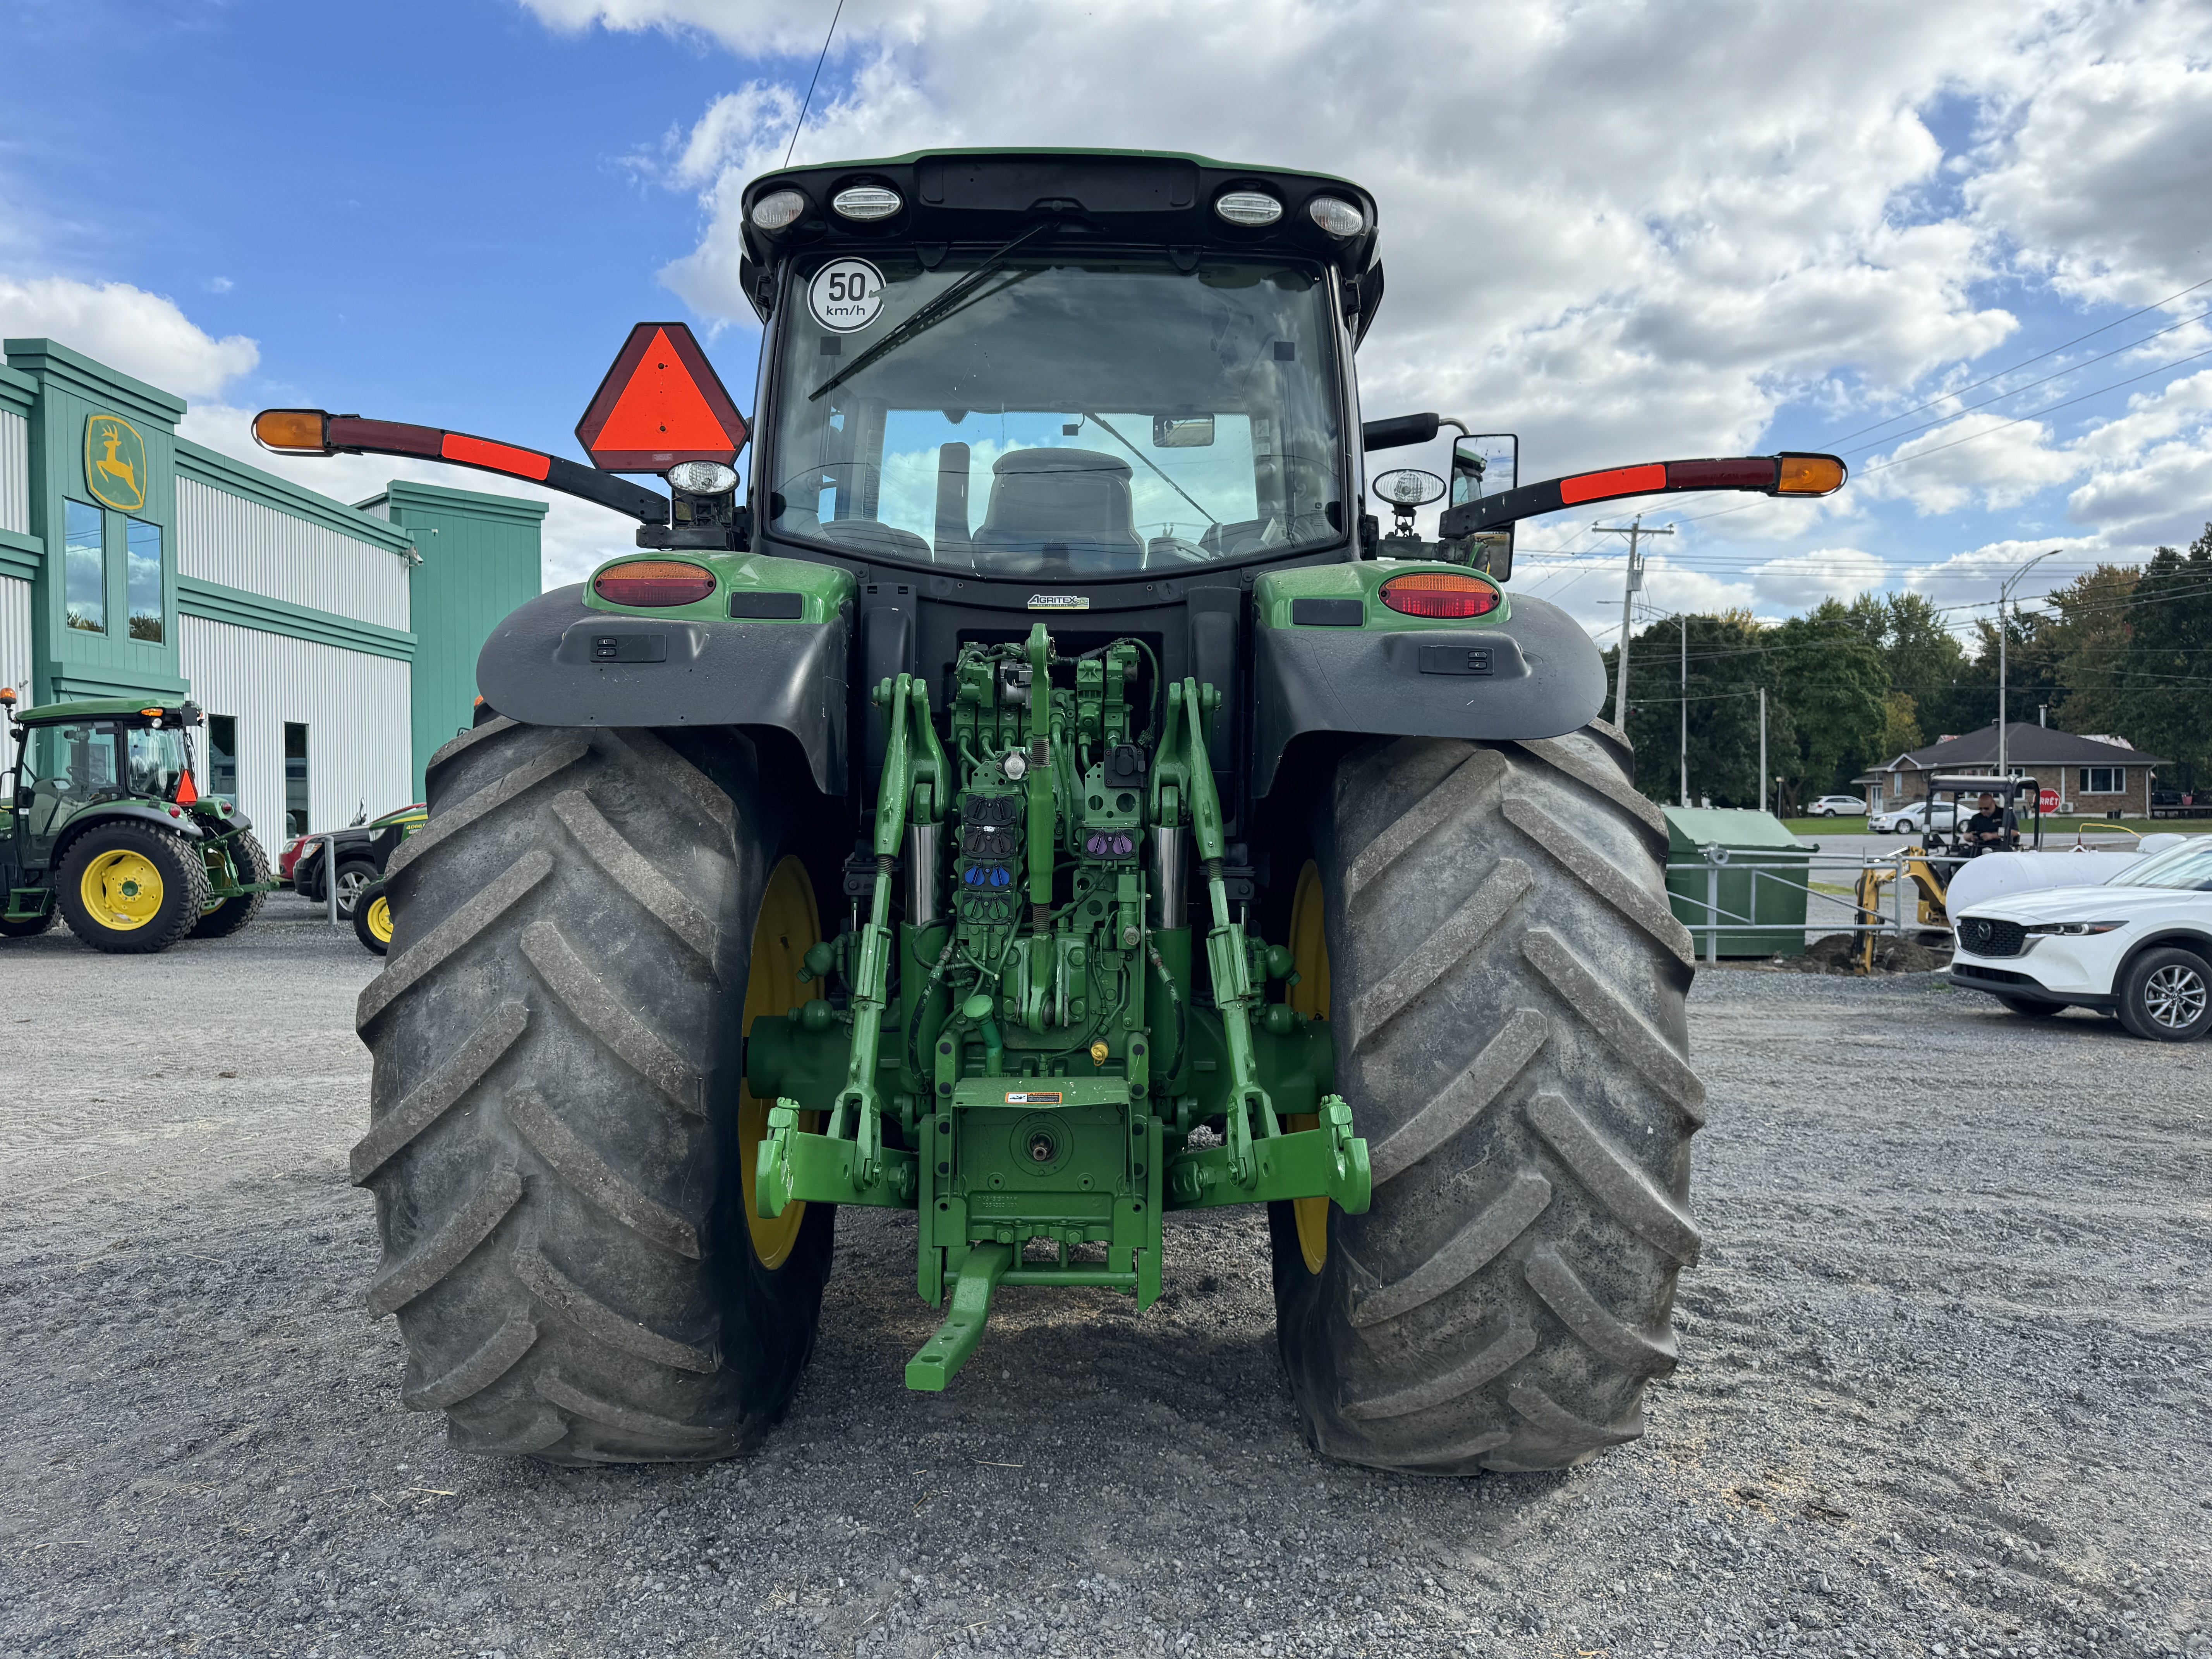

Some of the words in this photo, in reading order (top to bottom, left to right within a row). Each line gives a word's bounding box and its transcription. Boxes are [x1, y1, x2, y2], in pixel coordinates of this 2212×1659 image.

[828, 273, 866, 301] 50
[826, 305, 866, 316] km/h
[1029, 595, 1076, 603] AGRITEX
[2040, 797, 2059, 806] RRÊT
